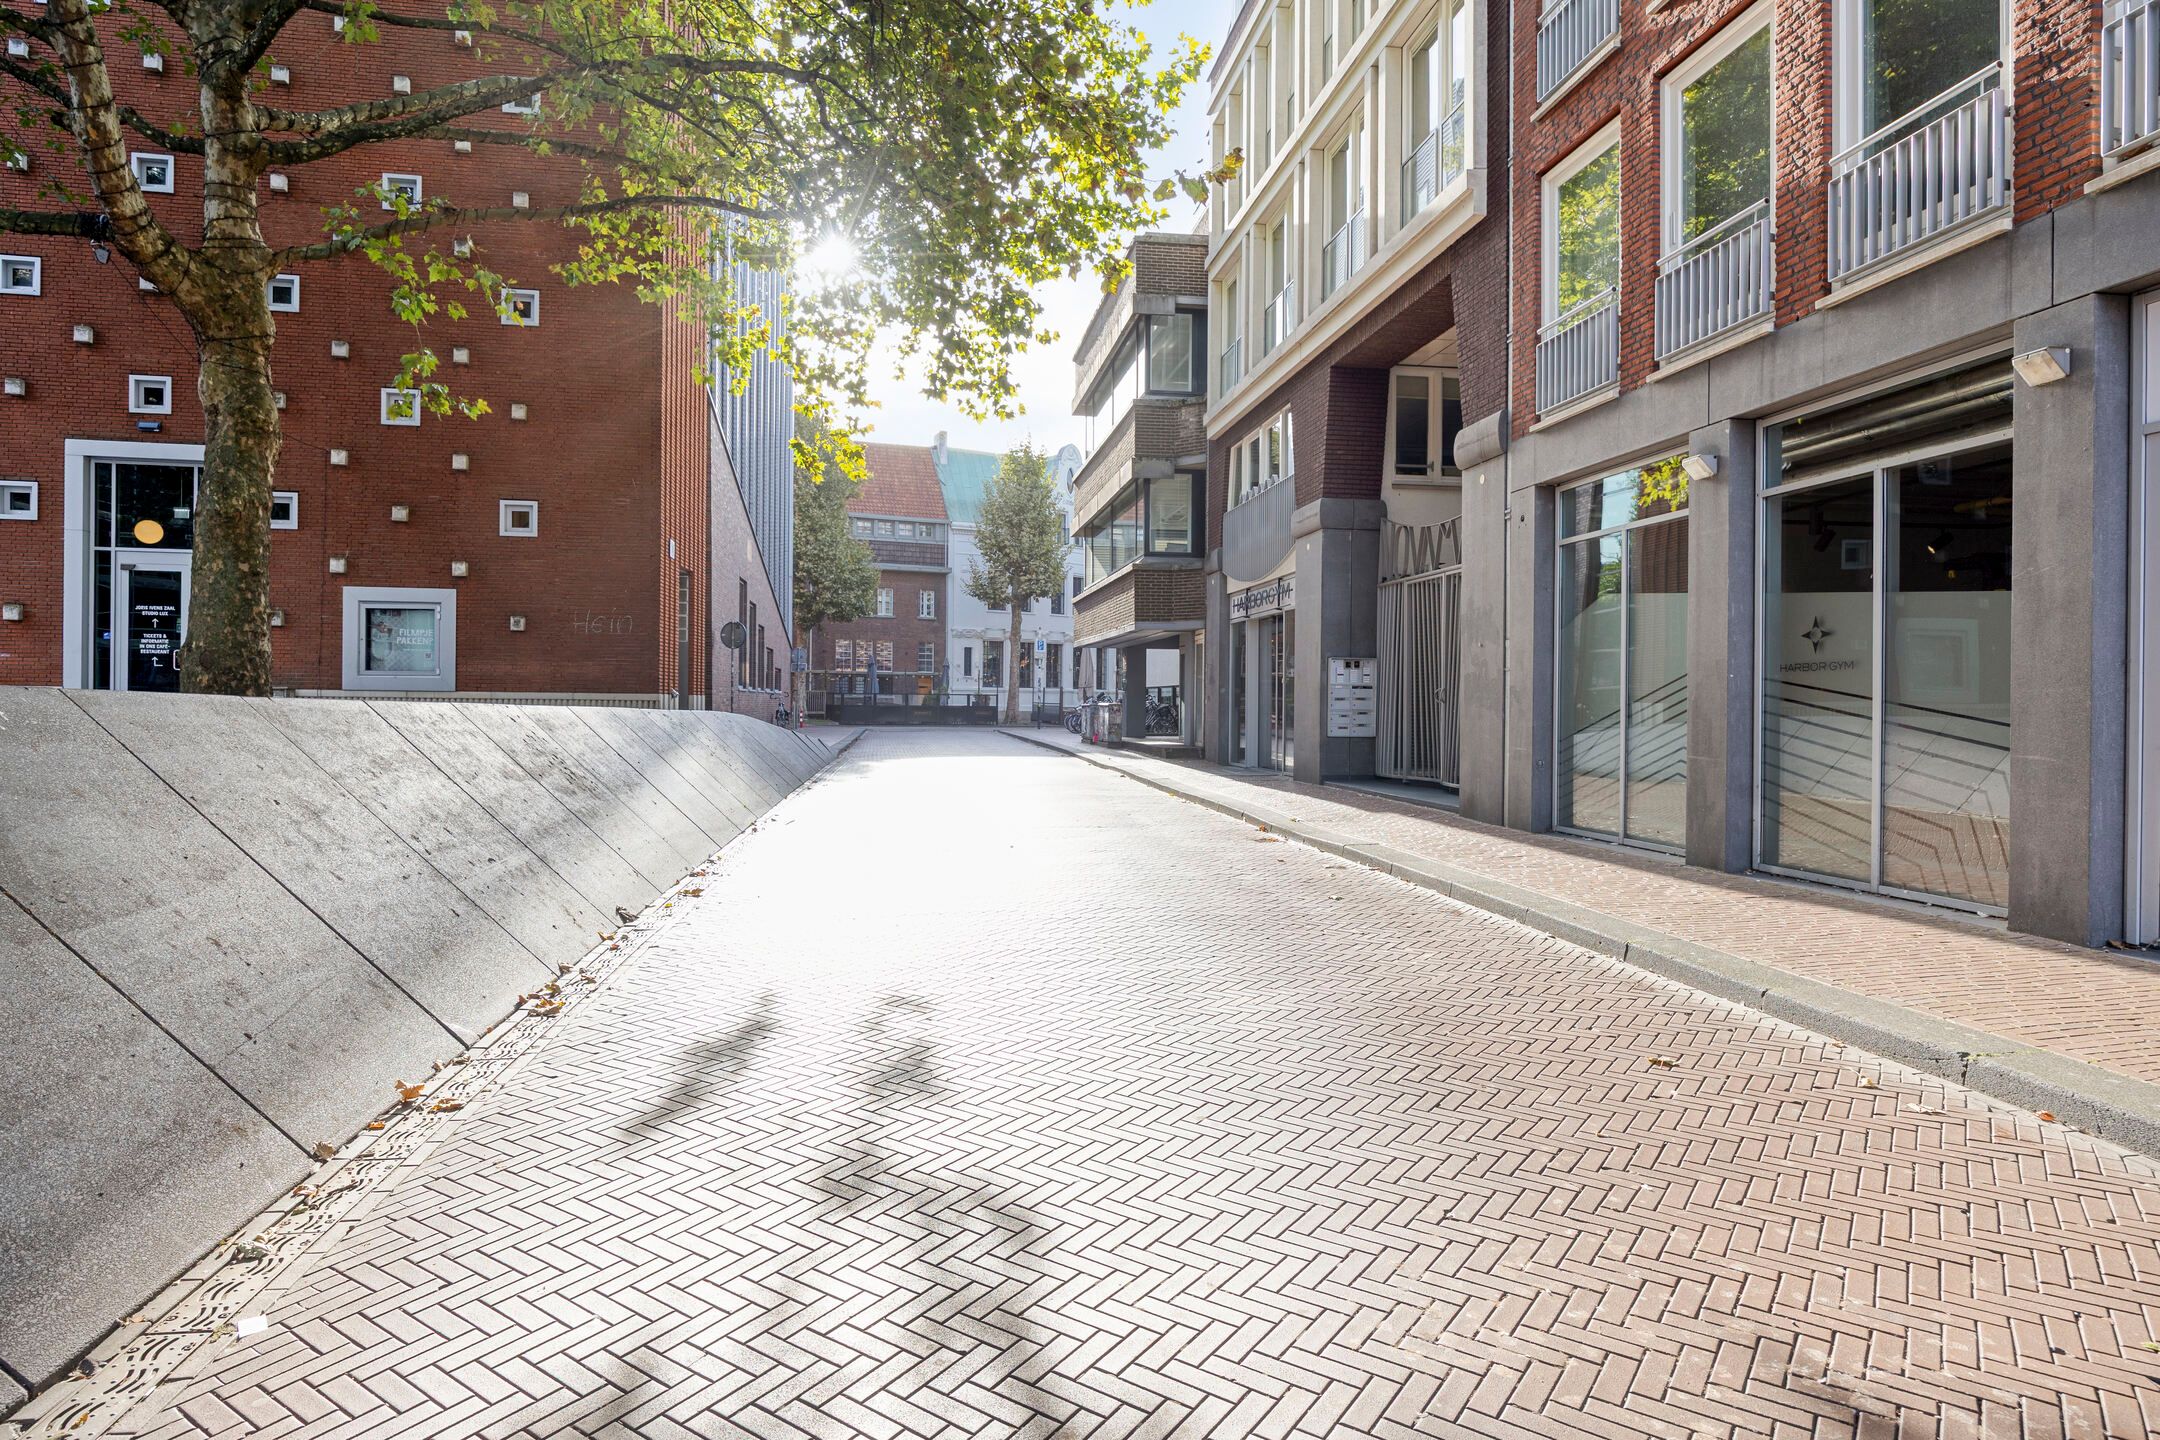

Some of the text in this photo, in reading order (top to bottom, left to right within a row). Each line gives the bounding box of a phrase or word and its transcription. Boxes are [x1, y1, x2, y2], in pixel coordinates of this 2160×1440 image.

[1232, 582, 1291, 614] HARBOR GYM
[399, 628, 433, 637] FILMPJE
[396, 637, 434, 645] PAKKEN?
[1779, 660, 1855, 673] HARBOR GYM
